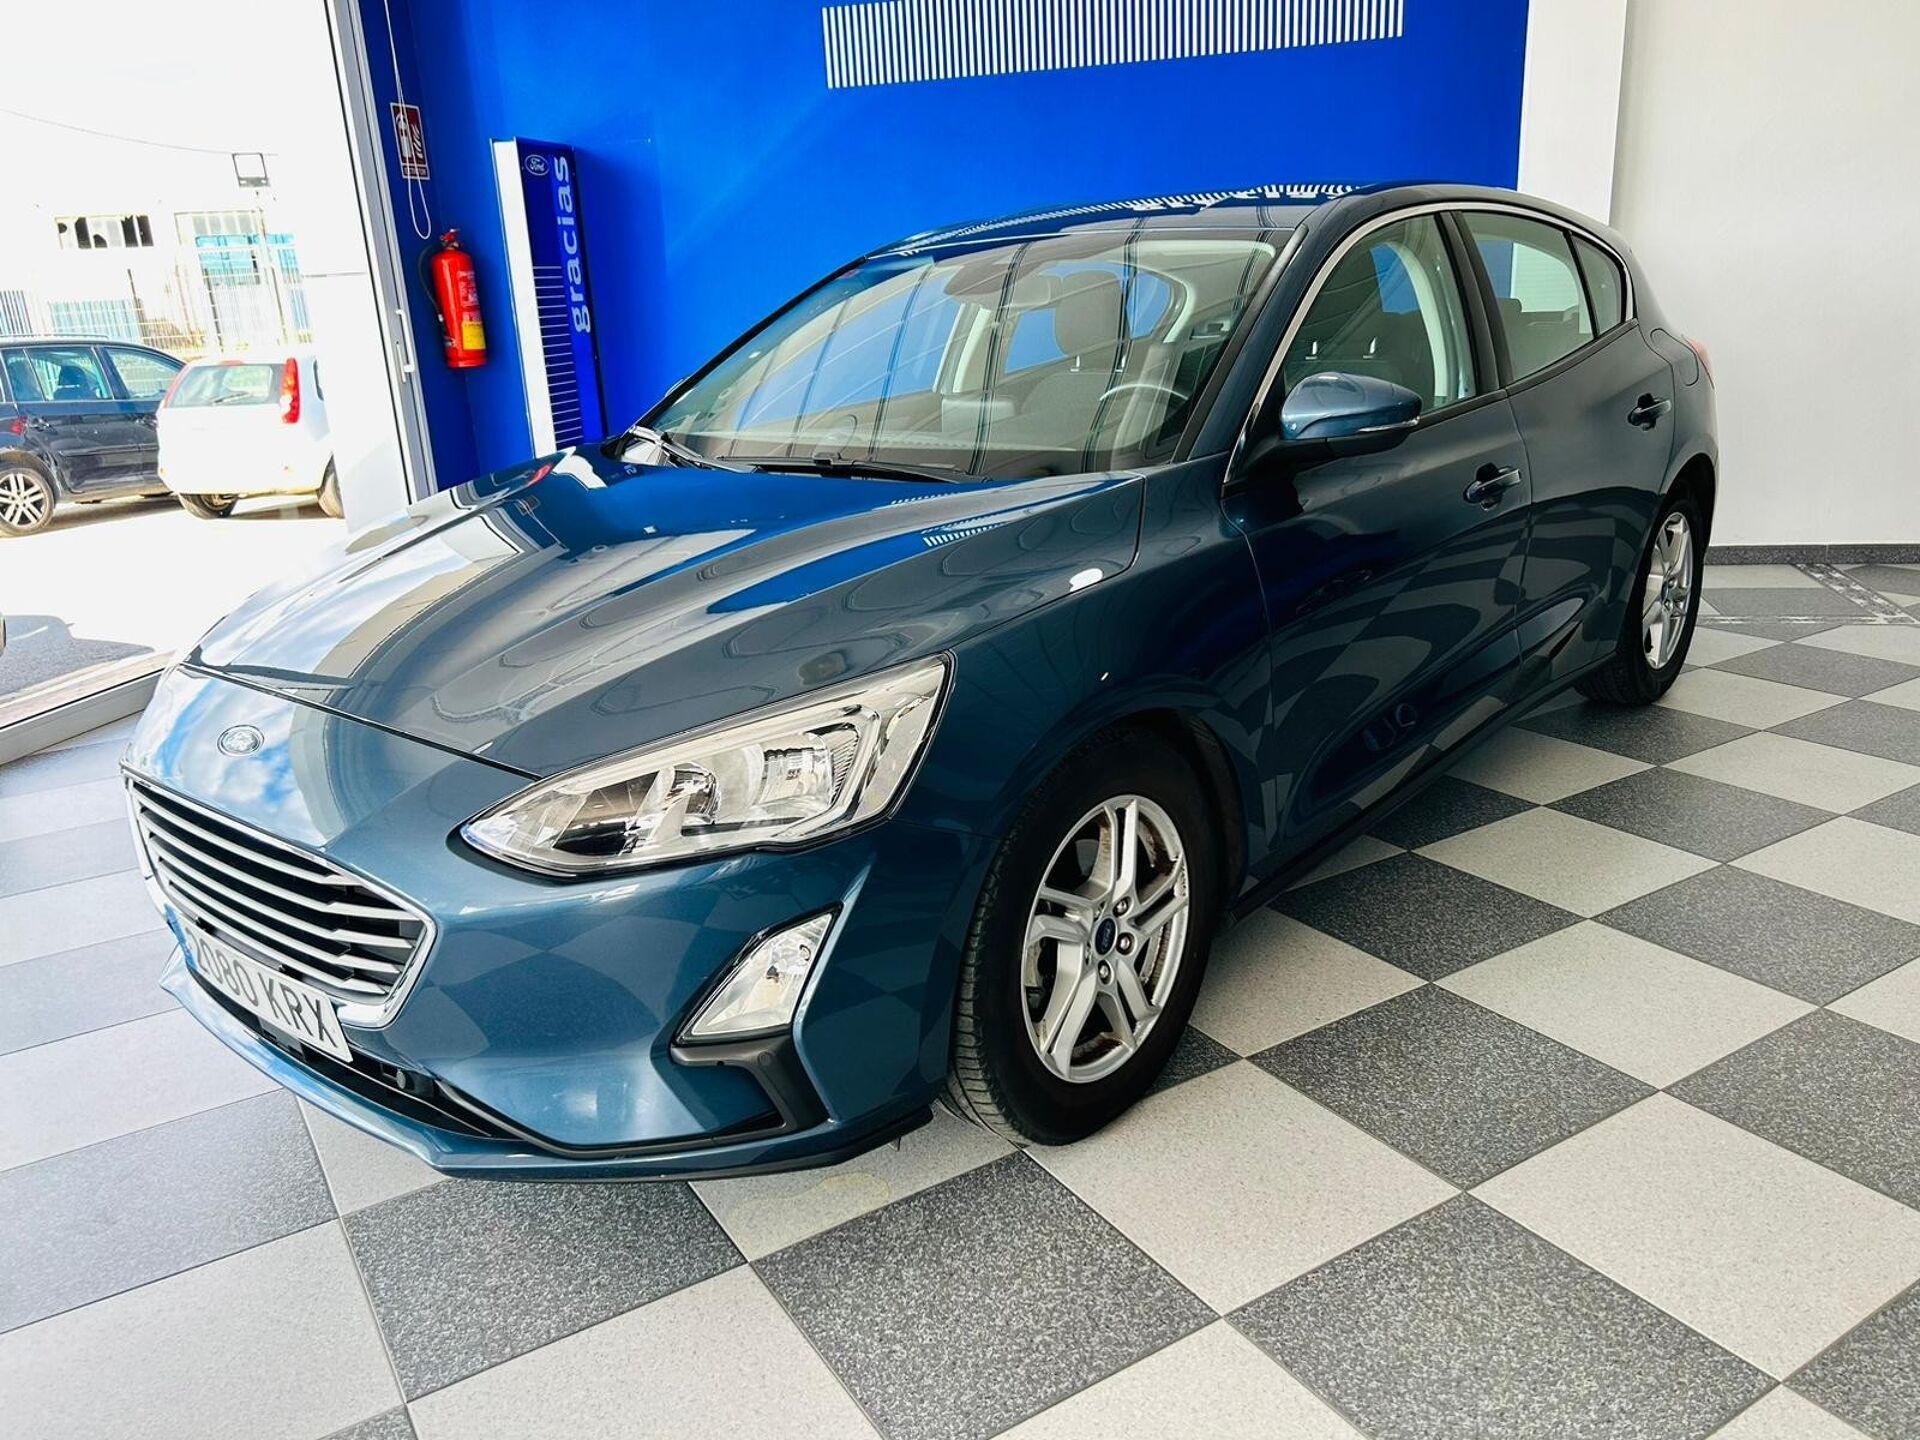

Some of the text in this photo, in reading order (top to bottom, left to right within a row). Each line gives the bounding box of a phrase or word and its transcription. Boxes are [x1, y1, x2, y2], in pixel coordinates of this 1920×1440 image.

[554, 156, 591, 333] gracias
[185, 927, 338, 1048] 2080 KRX
